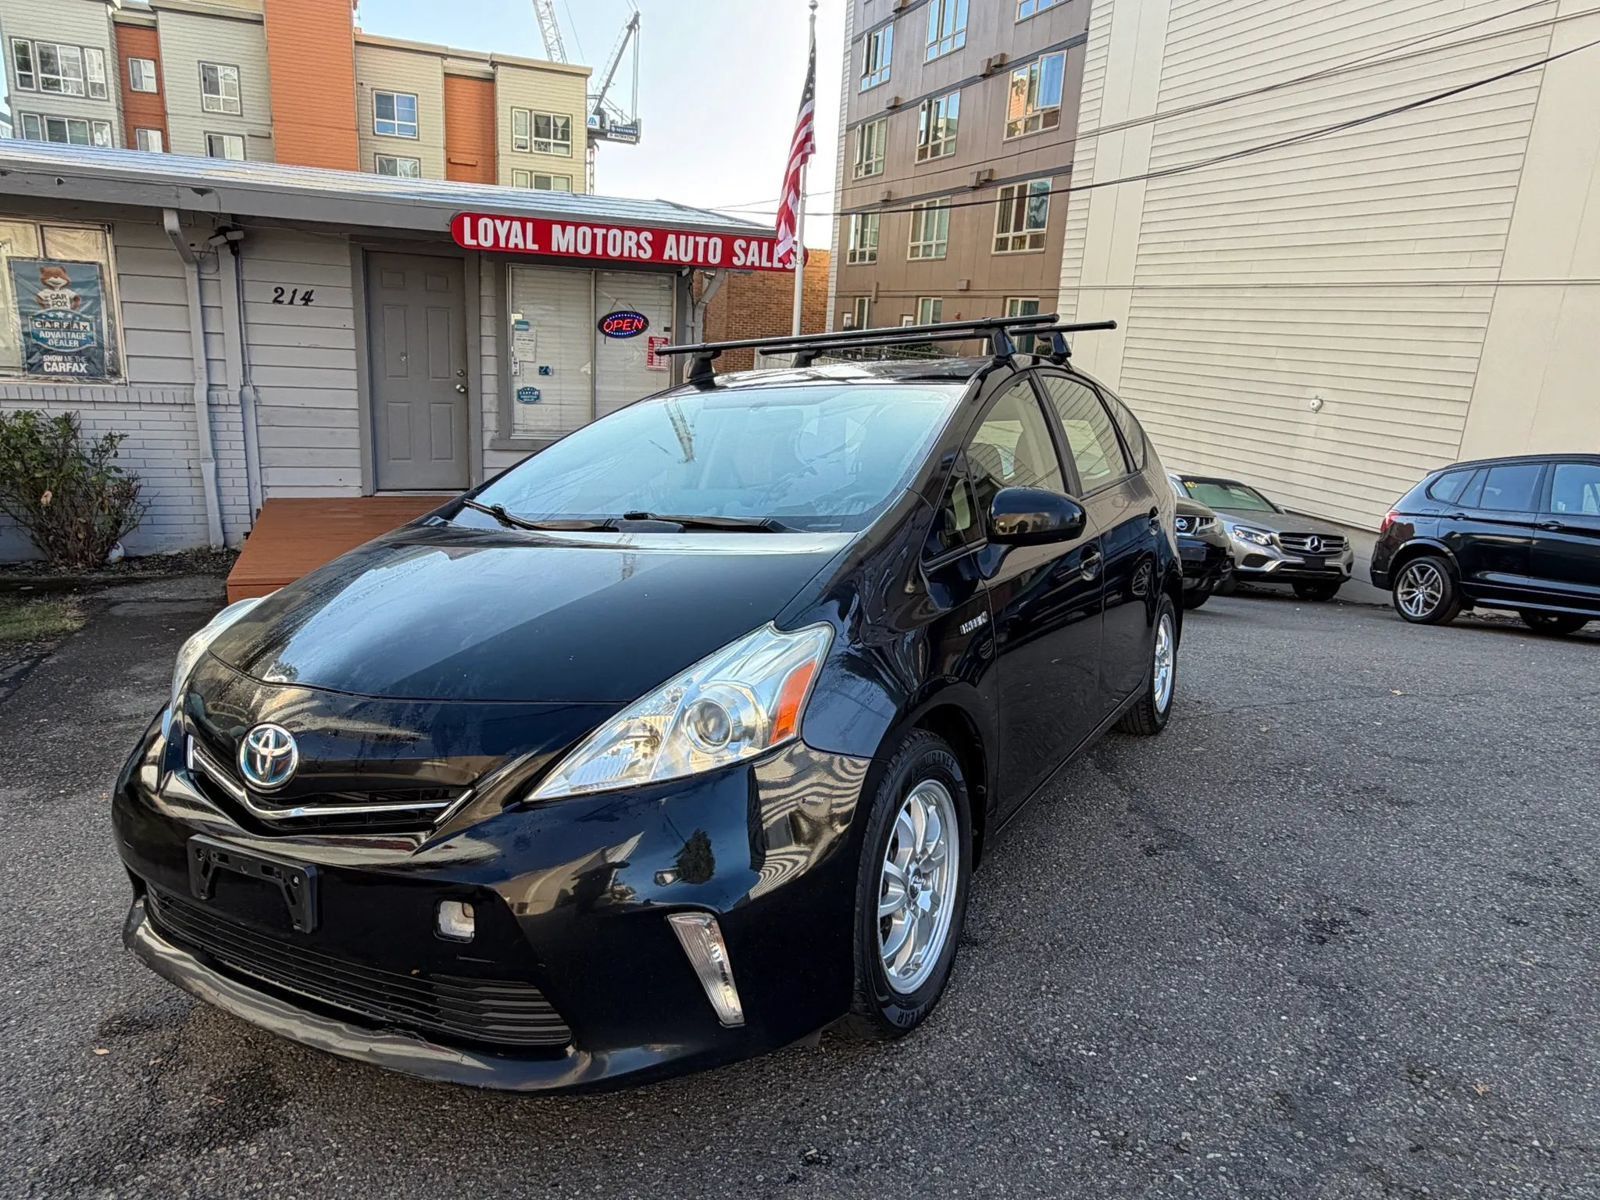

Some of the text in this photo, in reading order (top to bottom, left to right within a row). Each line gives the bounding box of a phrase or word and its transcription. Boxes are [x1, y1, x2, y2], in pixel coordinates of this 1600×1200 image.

[463, 216, 539, 251] LOYAL
[551, 224, 653, 259] MOTORS
[663, 234, 723, 264] AUTO
[272, 286, 314, 306] 214
[51, 300, 68, 308] FOX
[35, 321, 90, 331] CARFAX
[603, 319, 644, 332] OPEN
[40, 331, 87, 340] ADVANTAGE
[48, 339, 79, 347] DEALER
[43, 354, 63, 362] SHOW
[44, 361, 88, 373] CARFAX
